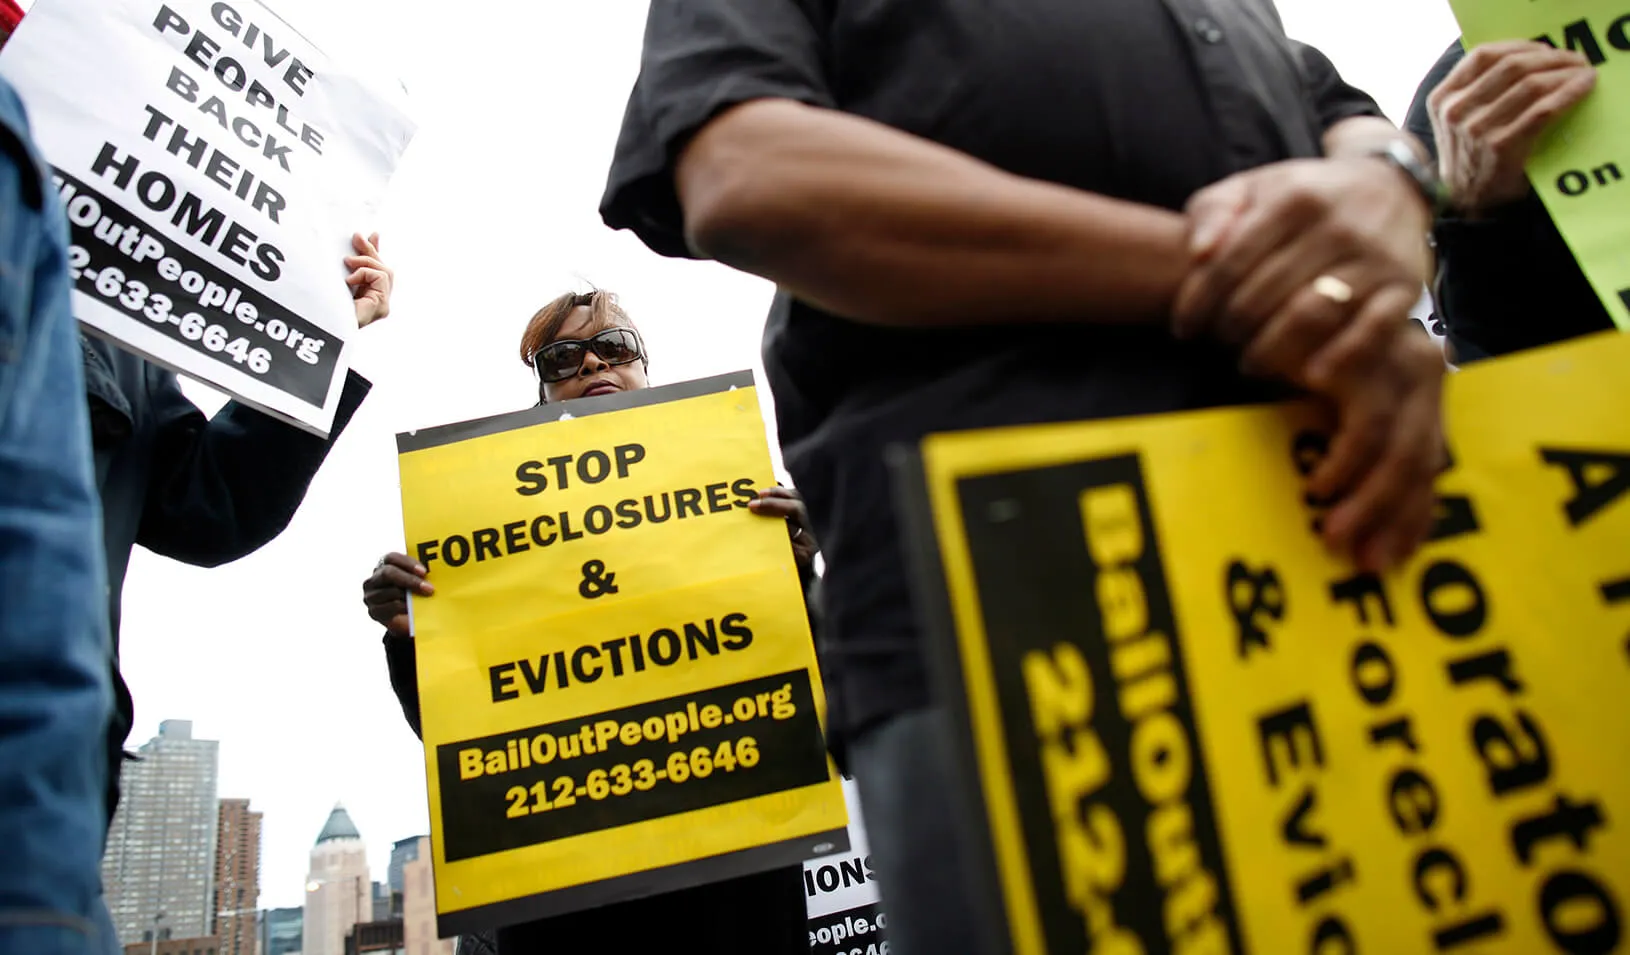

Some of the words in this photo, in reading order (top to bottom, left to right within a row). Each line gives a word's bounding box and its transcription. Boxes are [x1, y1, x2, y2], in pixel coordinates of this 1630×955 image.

[153, 5, 325, 156] PEOPLE
[211, 2, 315, 97] GIVE
[144, 104, 288, 225] THEIR
[166, 66, 293, 173] BACK
[90, 141, 286, 282] HOMES
[1556, 162, 1623, 196] On
[515, 443, 646, 496] STOP
[416, 478, 760, 573] FORECLOSURES
[578, 559, 619, 599] &
[1222, 556, 1289, 663] &
[488, 612, 754, 703] EVICTIONS
[1417, 445, 1624, 955] orato
[459, 683, 796, 781] BailOutPeople.org
[505, 736, 760, 819] 212-633-6646
